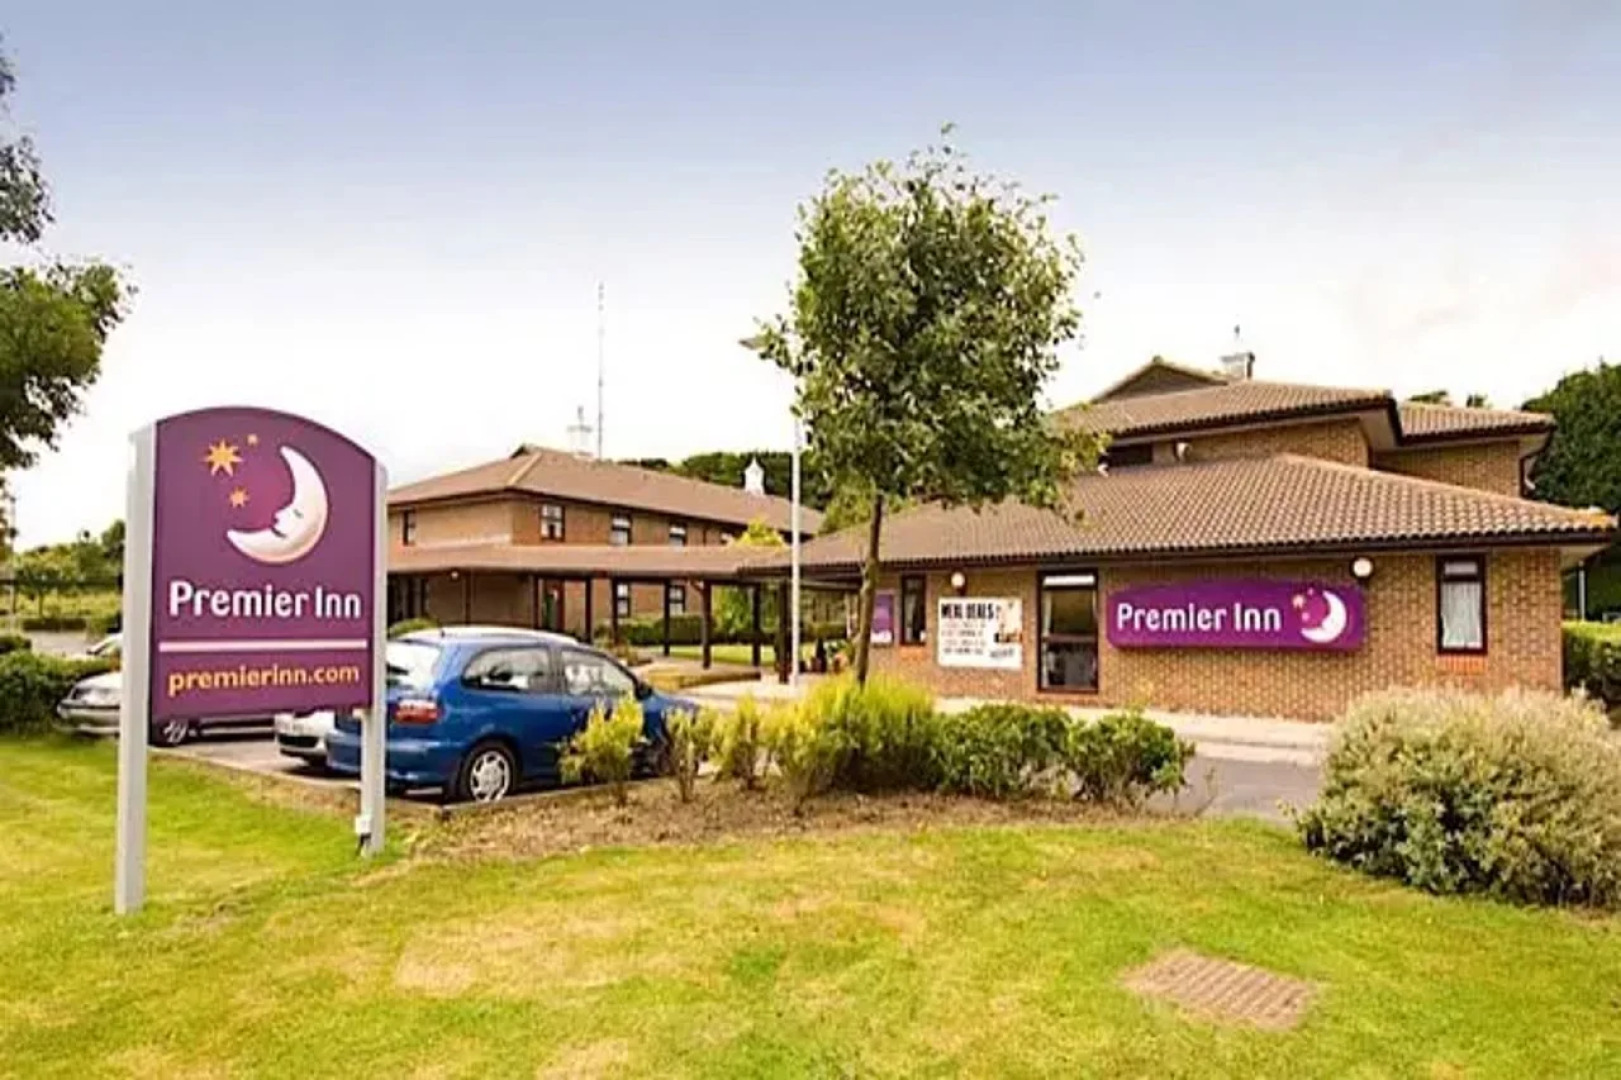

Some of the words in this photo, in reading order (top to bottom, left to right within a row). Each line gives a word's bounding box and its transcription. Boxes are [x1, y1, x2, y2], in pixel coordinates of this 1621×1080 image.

[169, 580, 309, 617] Premier
[315, 586, 361, 617] Inn
[1117, 602, 1227, 631] Premier
[1234, 602, 1282, 631] Inn
[168, 663, 359, 697] premierinn.com
